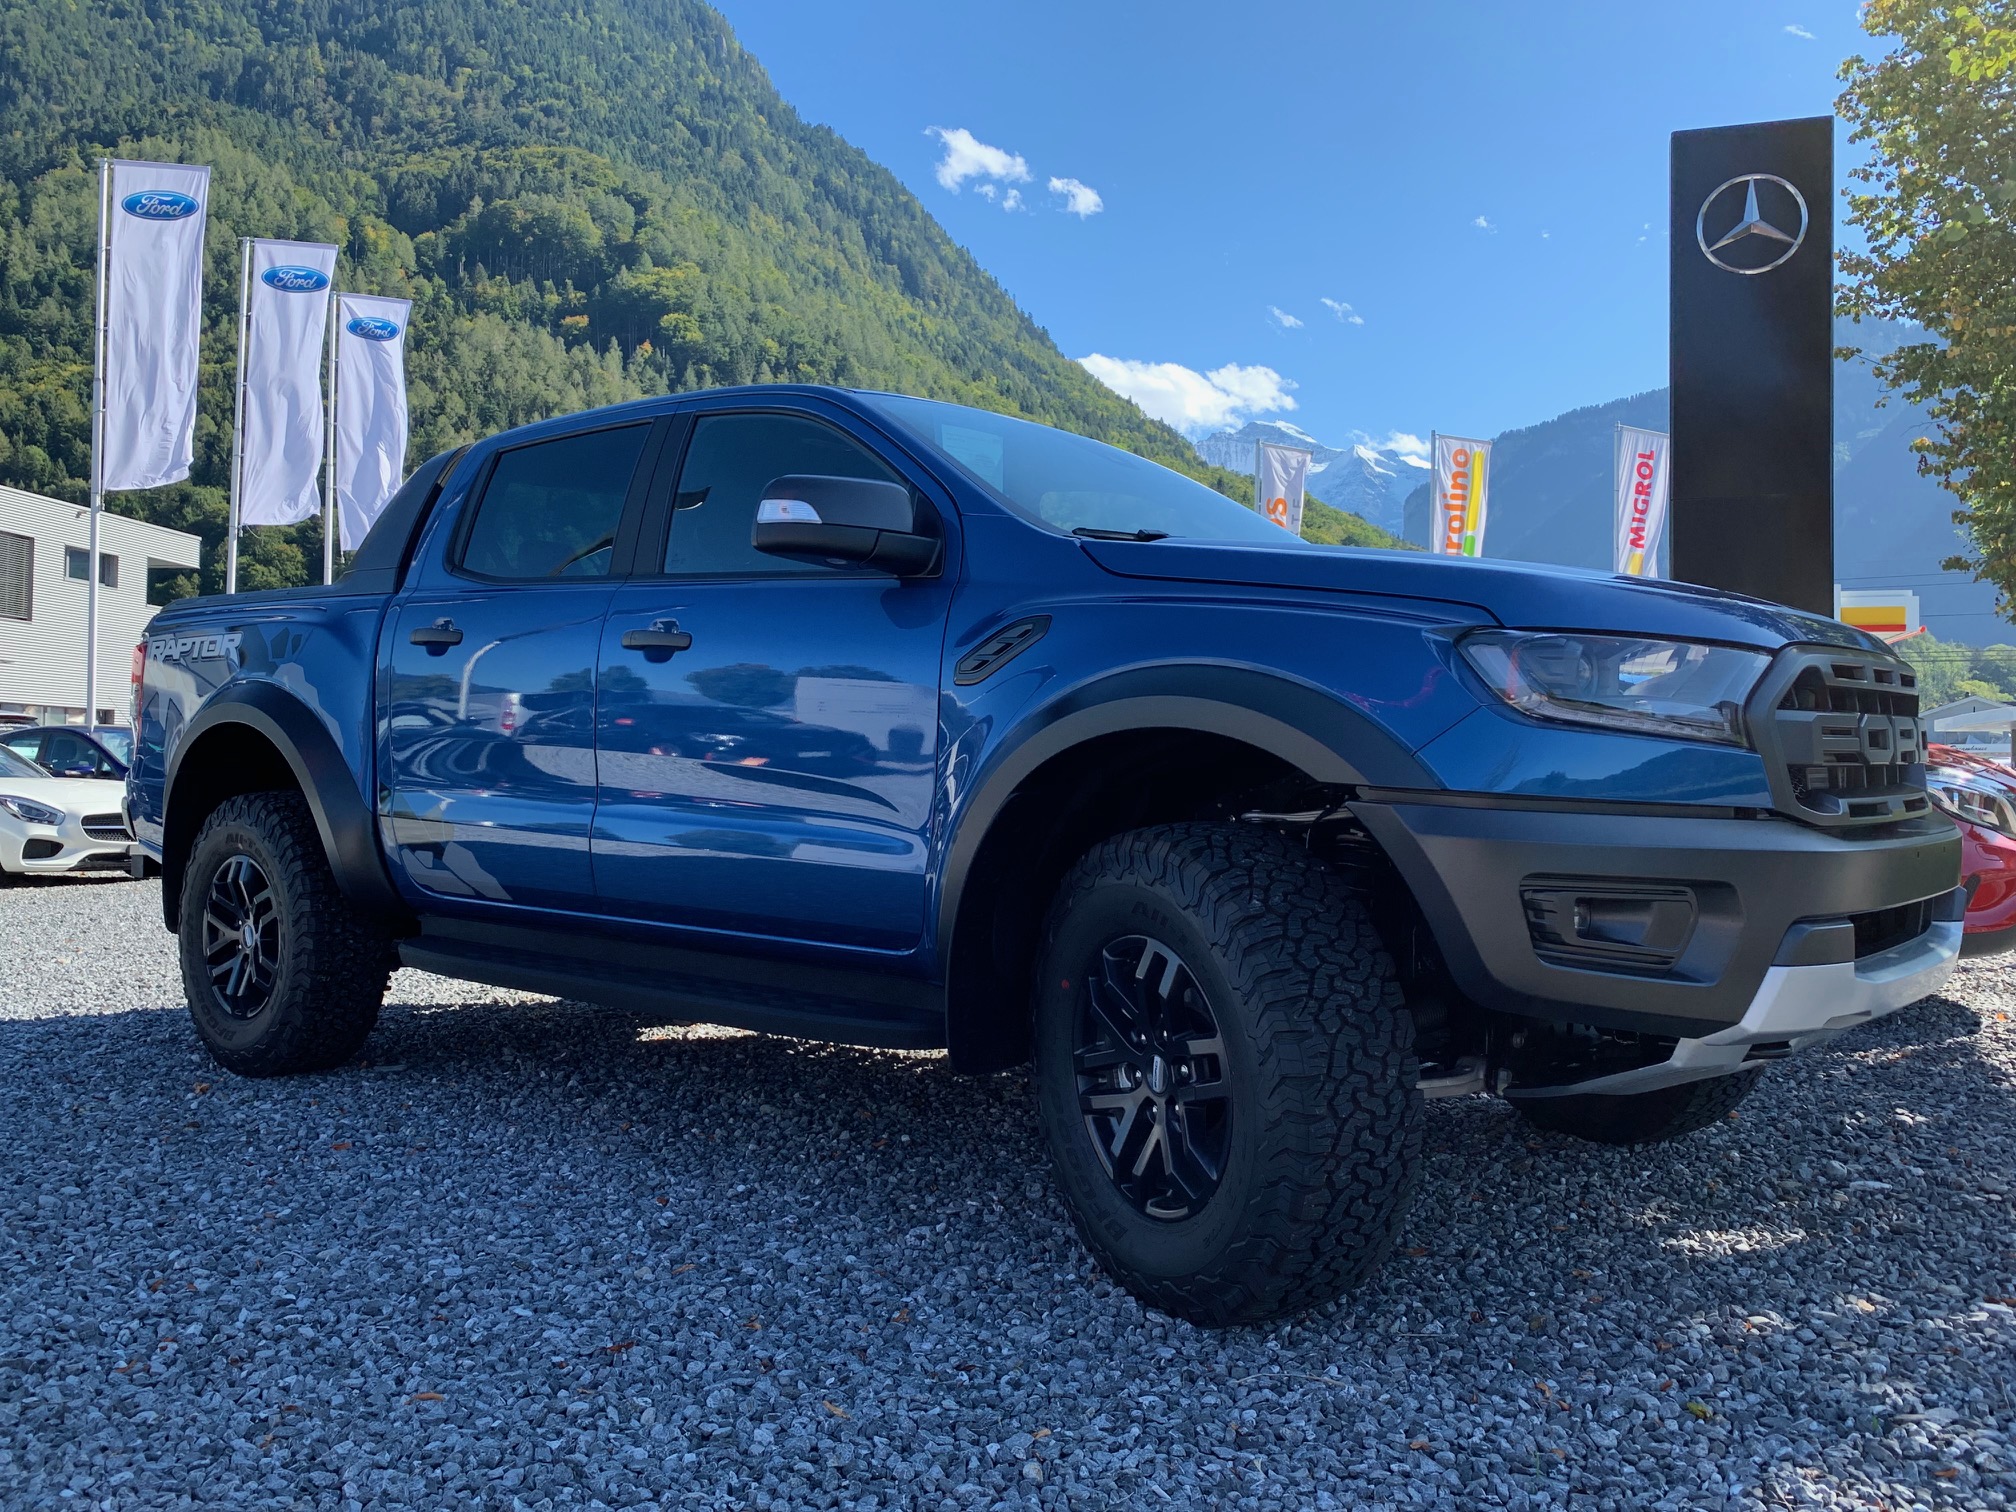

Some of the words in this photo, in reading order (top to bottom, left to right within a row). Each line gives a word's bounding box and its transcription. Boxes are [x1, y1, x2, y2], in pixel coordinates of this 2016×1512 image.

[136, 193, 186, 217] Ford
[273, 267, 318, 290] Ford
[357, 319, 393, 339] Ford
[1442, 448, 1470, 555] rolino
[1629, 450, 1655, 549] MIGROL
[150, 632, 244, 669] RAPTOR
